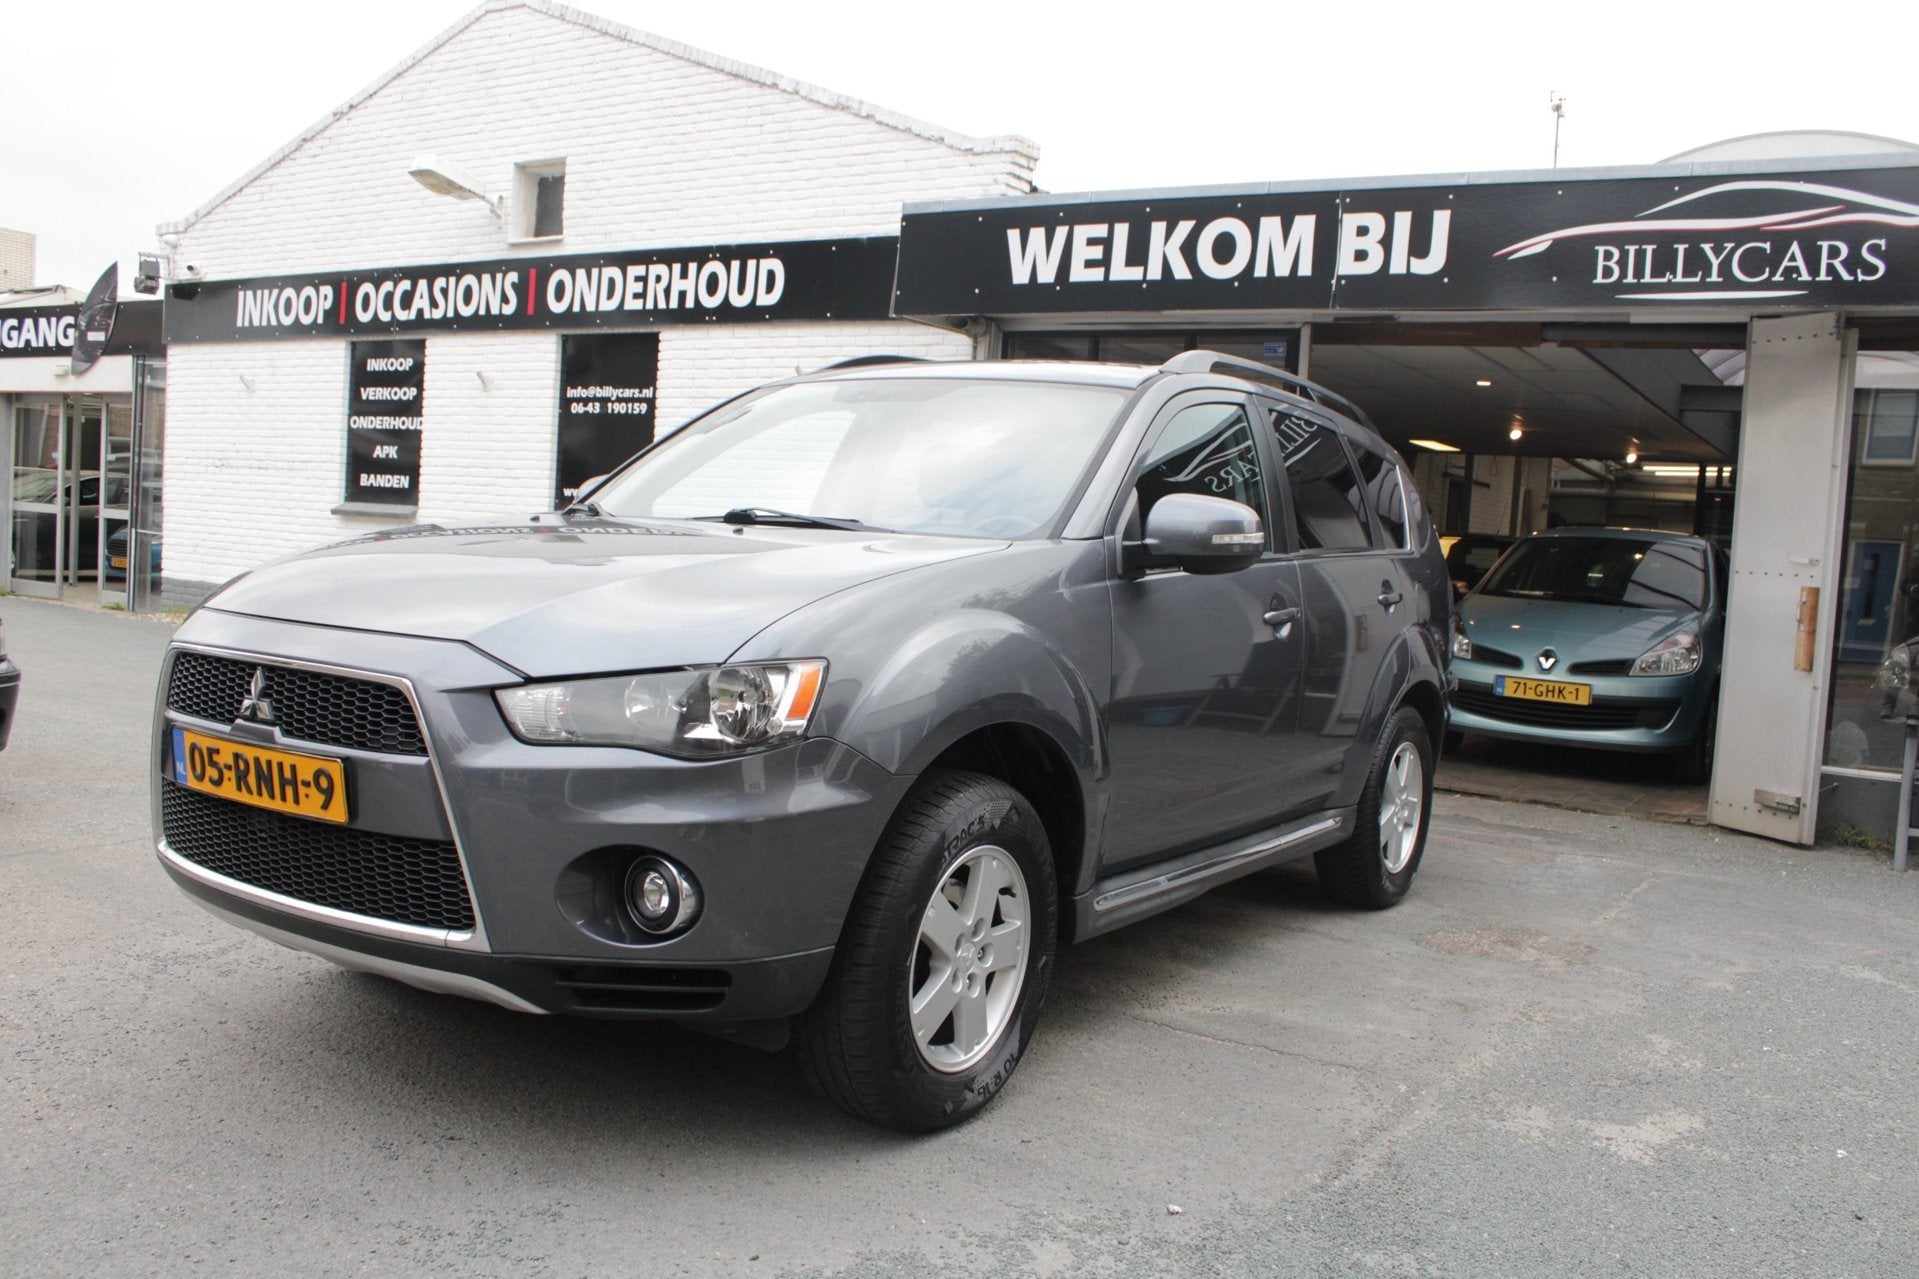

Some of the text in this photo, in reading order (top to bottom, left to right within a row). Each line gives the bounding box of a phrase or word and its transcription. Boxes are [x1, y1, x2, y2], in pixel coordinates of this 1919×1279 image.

[1007, 209, 1452, 285] WELKOM BIJ
[1593, 238, 1887, 284] BILLYCARS
[236, 257, 785, 327] INKOOP OCCASIONS ONDERHOUD
[0, 315, 75, 349] GANG
[366, 357, 414, 372] INKOOP
[360, 386, 418, 401] VERKOOP
[566, 385, 654, 401] info@billycars.nl
[570, 402, 648, 415] 06-43 190159
[350, 416, 424, 430] ONDERHOUD
[372, 445, 399, 459] APK
[359, 473, 410, 489] BANDEN
[1512, 680, 1580, 702] 71-GHK-1
[189, 741, 335, 811] 05-RNH-9
